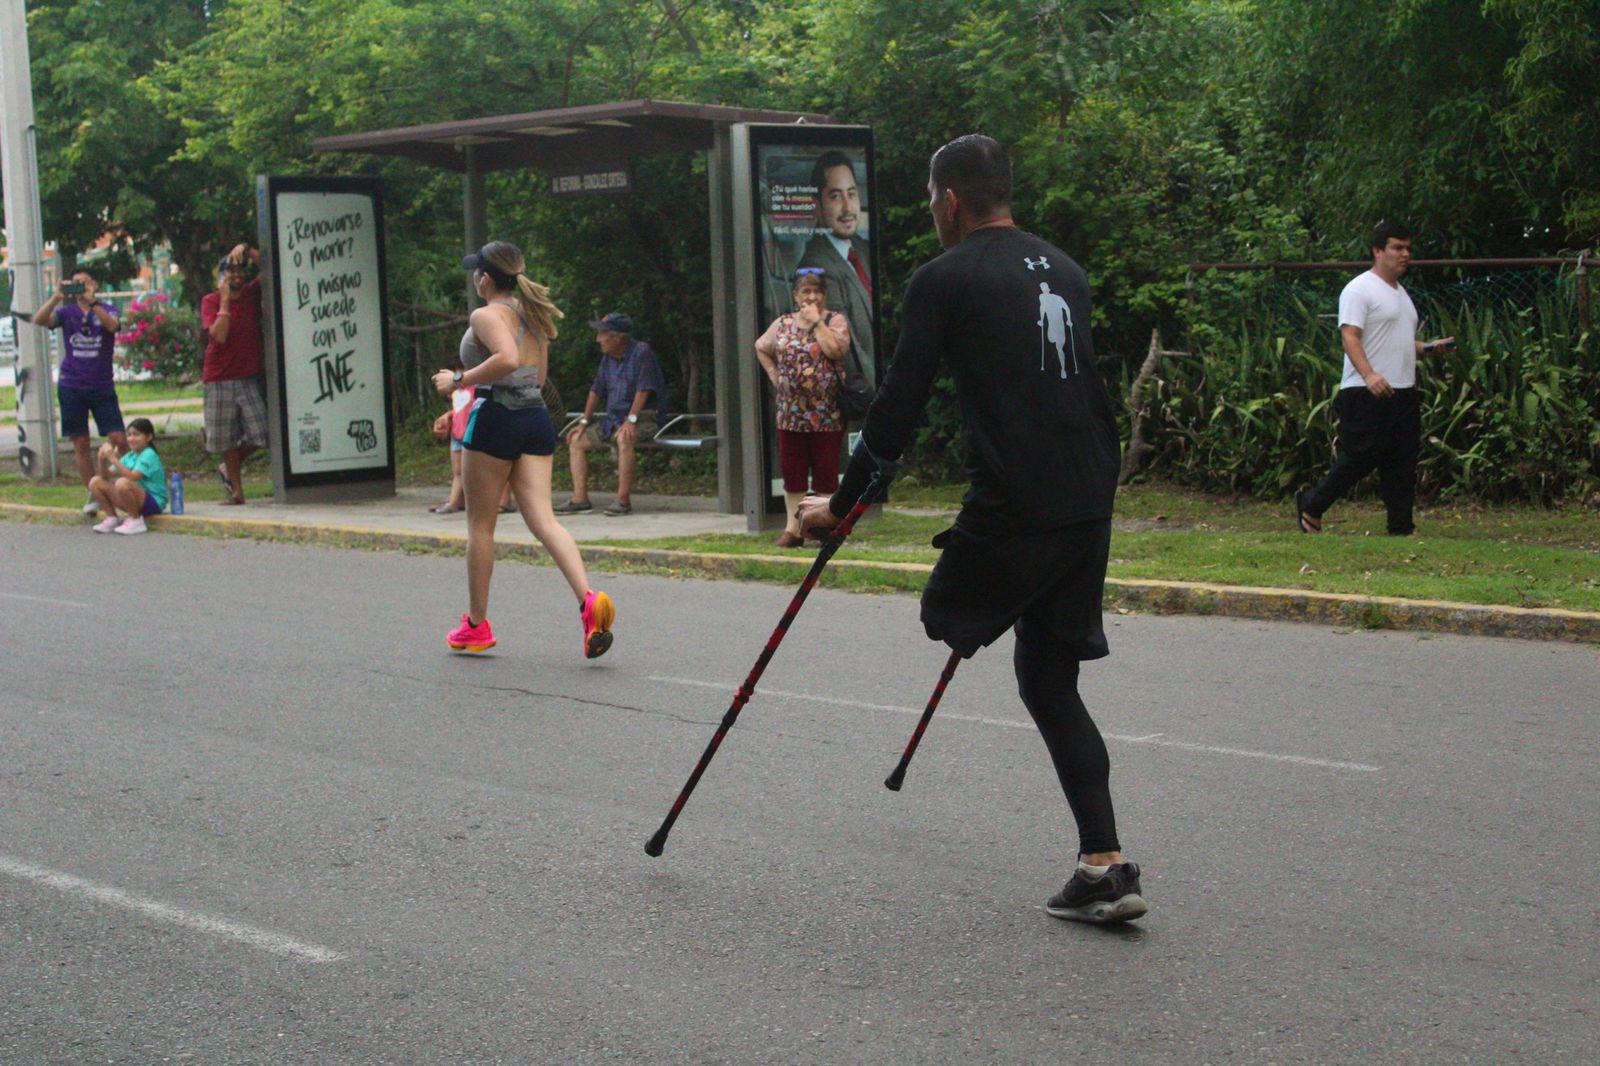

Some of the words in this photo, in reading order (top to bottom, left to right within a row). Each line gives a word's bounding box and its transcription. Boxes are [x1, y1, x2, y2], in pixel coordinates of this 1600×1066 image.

[286, 212, 362, 250] ¿Renovarse
[293, 251, 302, 268] o
[310, 236, 354, 270] morir?
[296, 277, 311, 310] Lo
[317, 270, 362, 303] mismo
[311, 291, 357, 323] sucede
[312, 322, 337, 349] con
[310, 349, 365, 405] INE.
